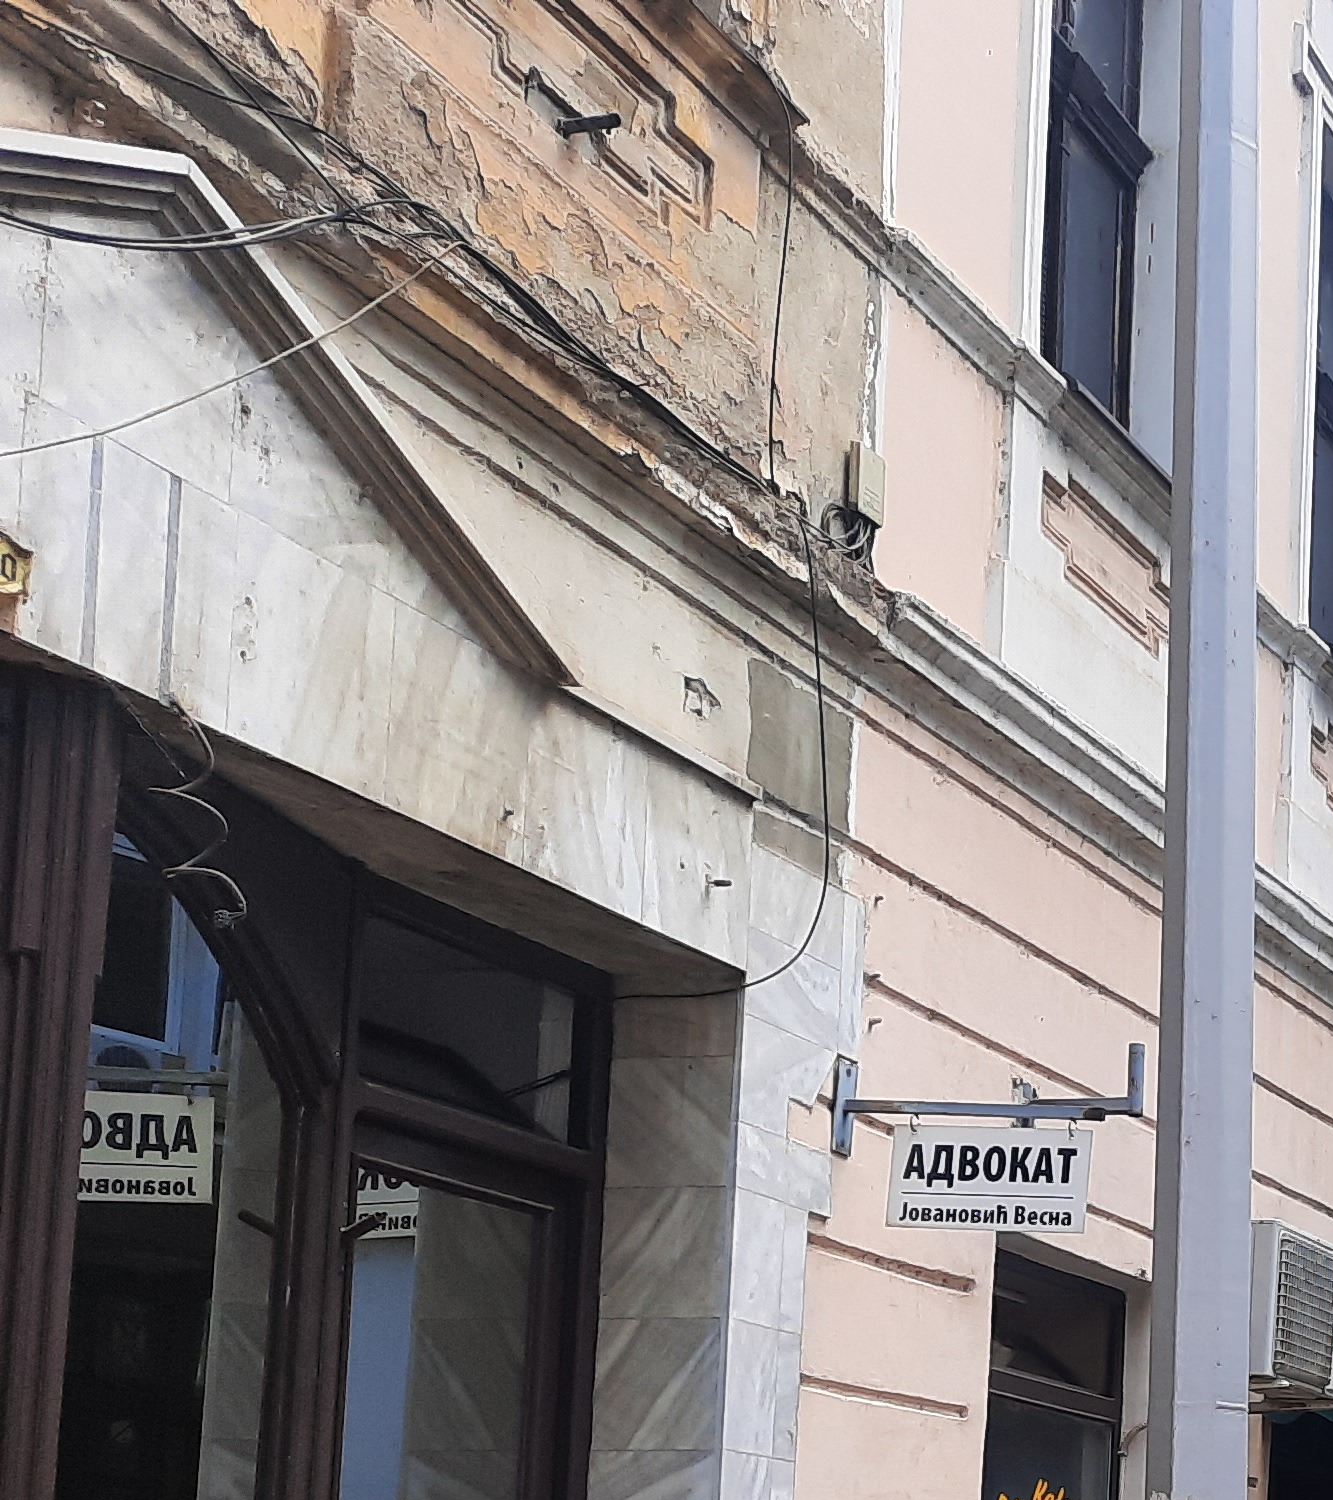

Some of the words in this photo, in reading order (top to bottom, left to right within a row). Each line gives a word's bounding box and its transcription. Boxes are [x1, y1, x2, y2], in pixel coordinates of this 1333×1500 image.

[903, 1144, 1078, 1188] АДВОКАТ
[899, 1202, 1008, 1225] Јовановић
[1014, 1206, 1072, 1226] Весна
